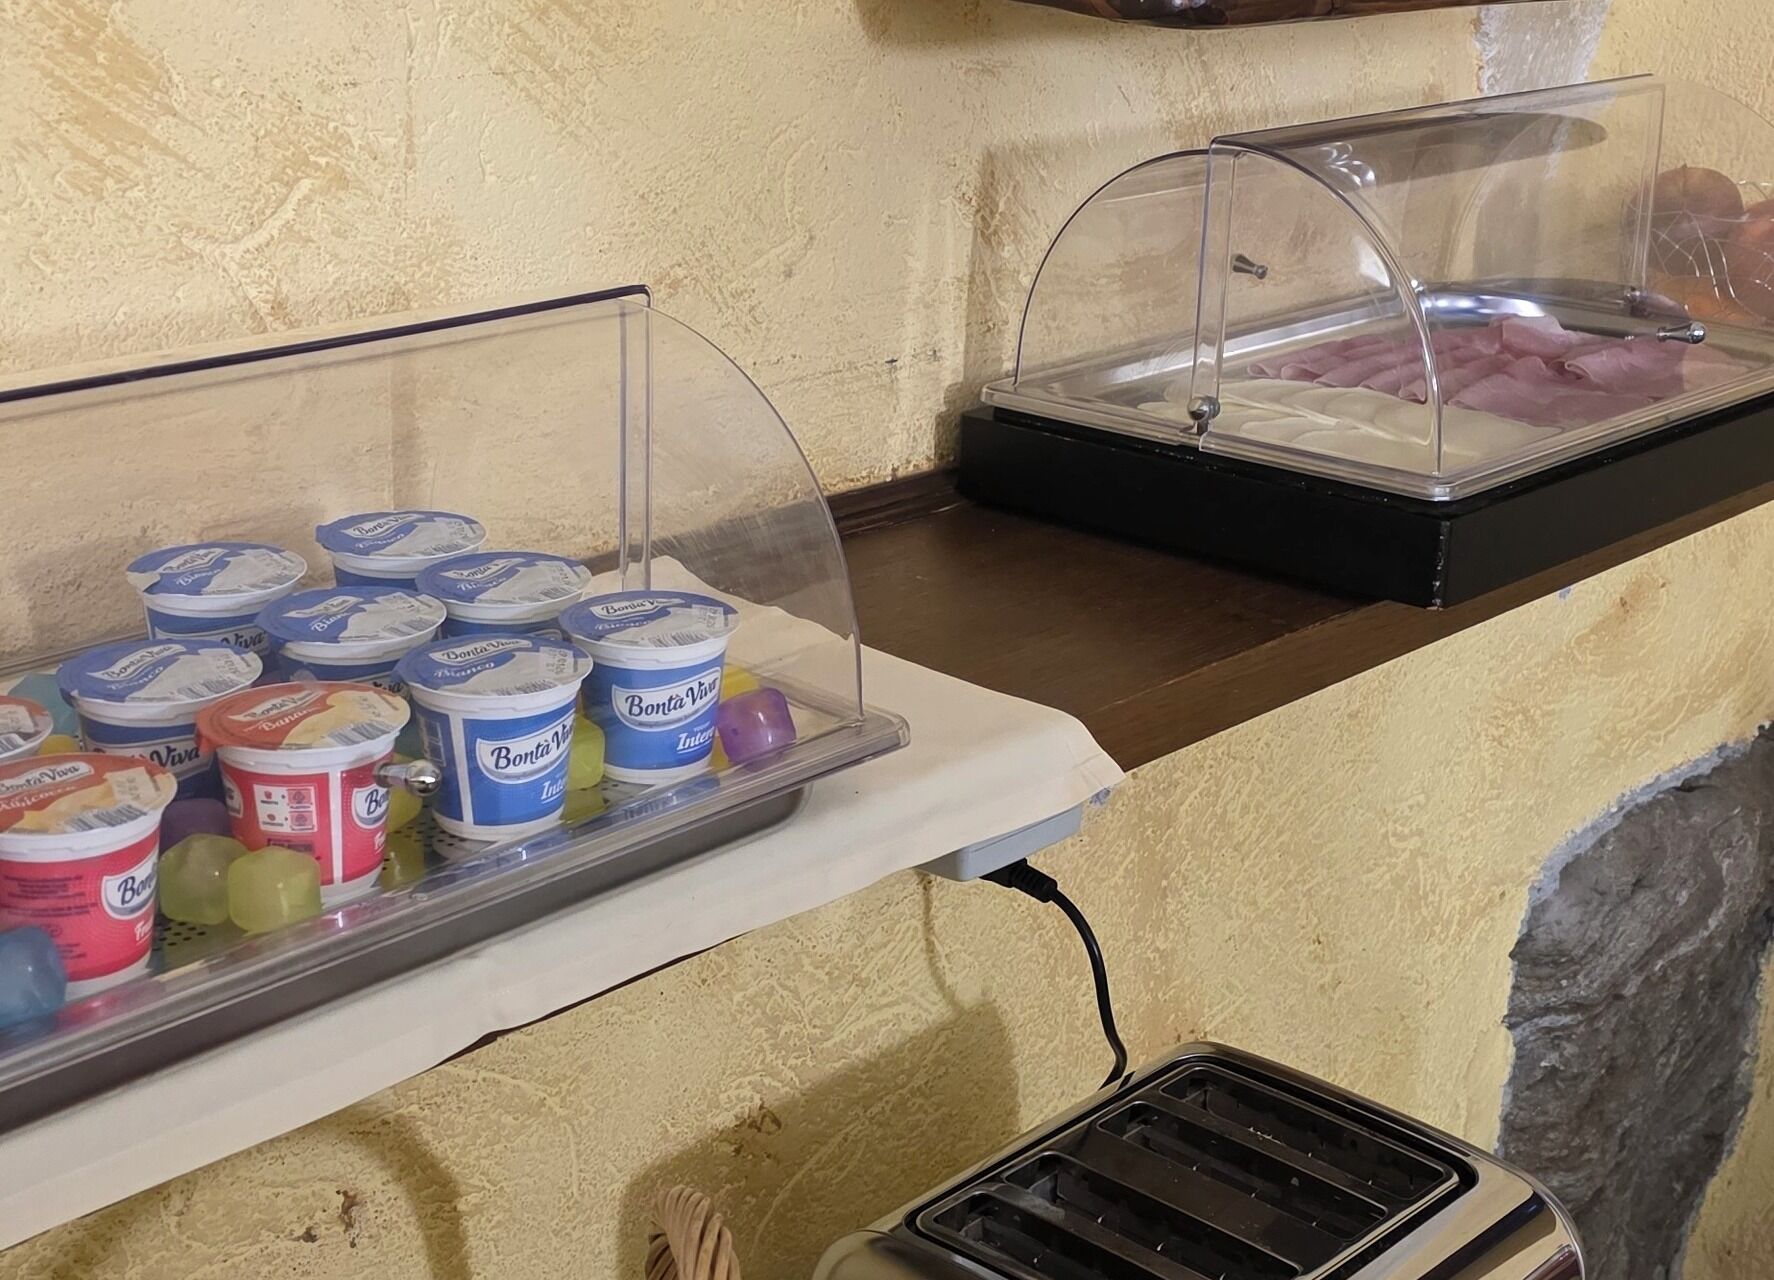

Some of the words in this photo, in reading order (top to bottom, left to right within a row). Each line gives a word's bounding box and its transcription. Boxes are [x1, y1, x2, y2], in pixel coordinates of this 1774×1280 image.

[625, 693, 686, 718] Bontà
[149, 744, 201, 769] Viva
[490, 738, 553, 770] Bontà
